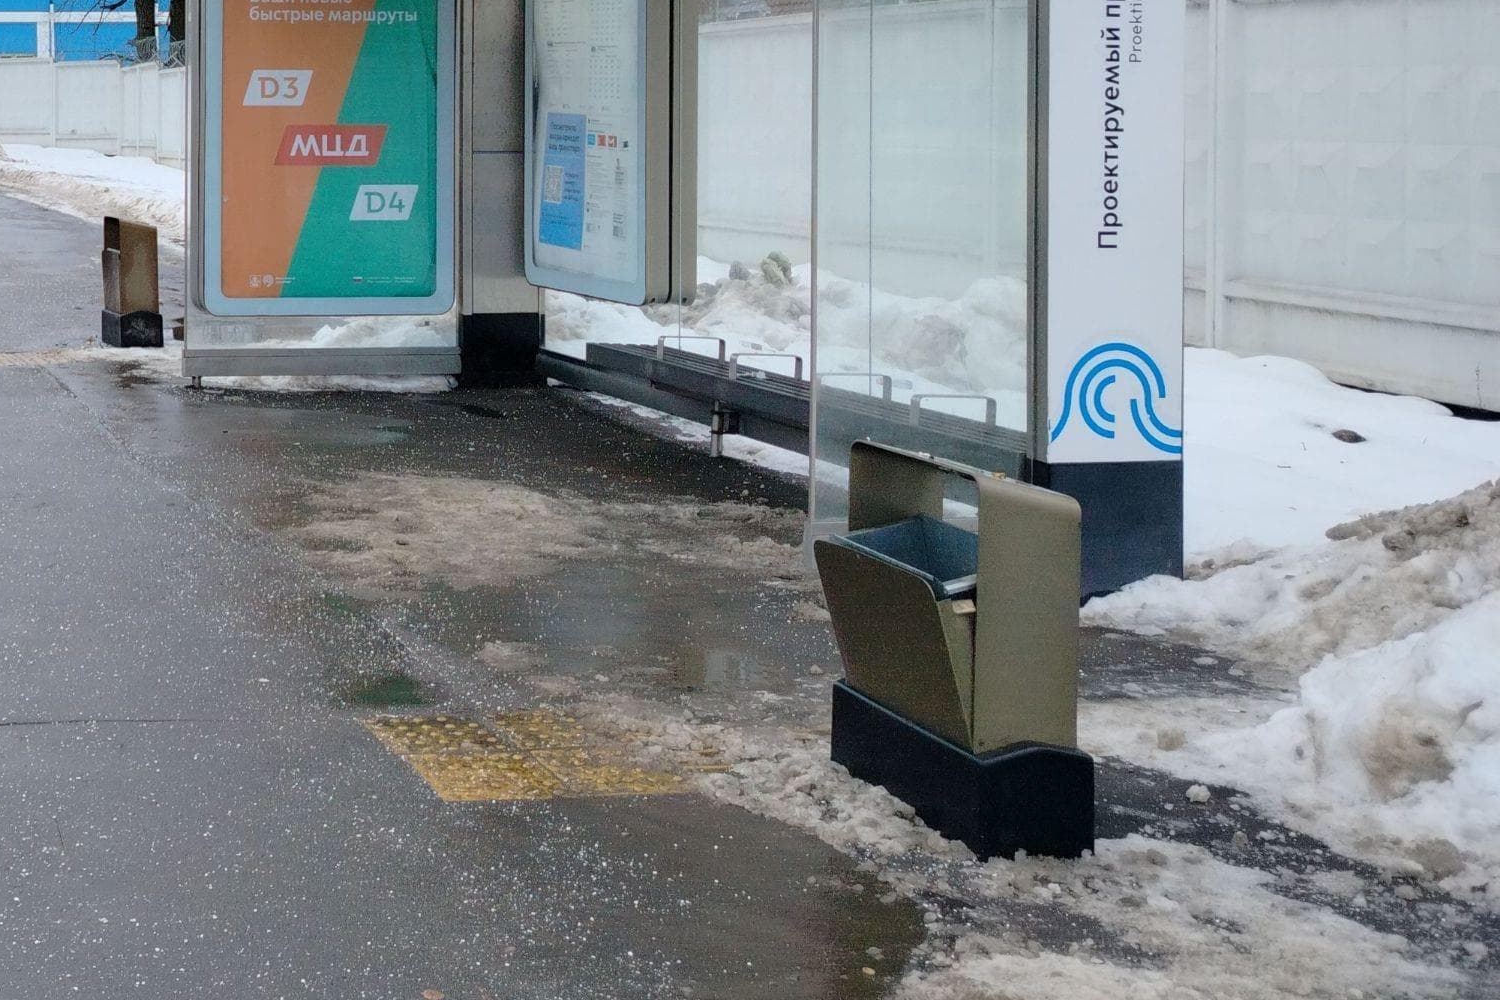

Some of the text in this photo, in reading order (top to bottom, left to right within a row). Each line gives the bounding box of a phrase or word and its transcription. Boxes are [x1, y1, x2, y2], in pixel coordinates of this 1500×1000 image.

[249, 6, 419, 26] быстрые маршруты
[257, 76, 300, 99] D3
[289, 134, 370, 157] МЦД
[1098, 29, 1125, 249] Проектируемый
[364, 191, 406, 214] D4
